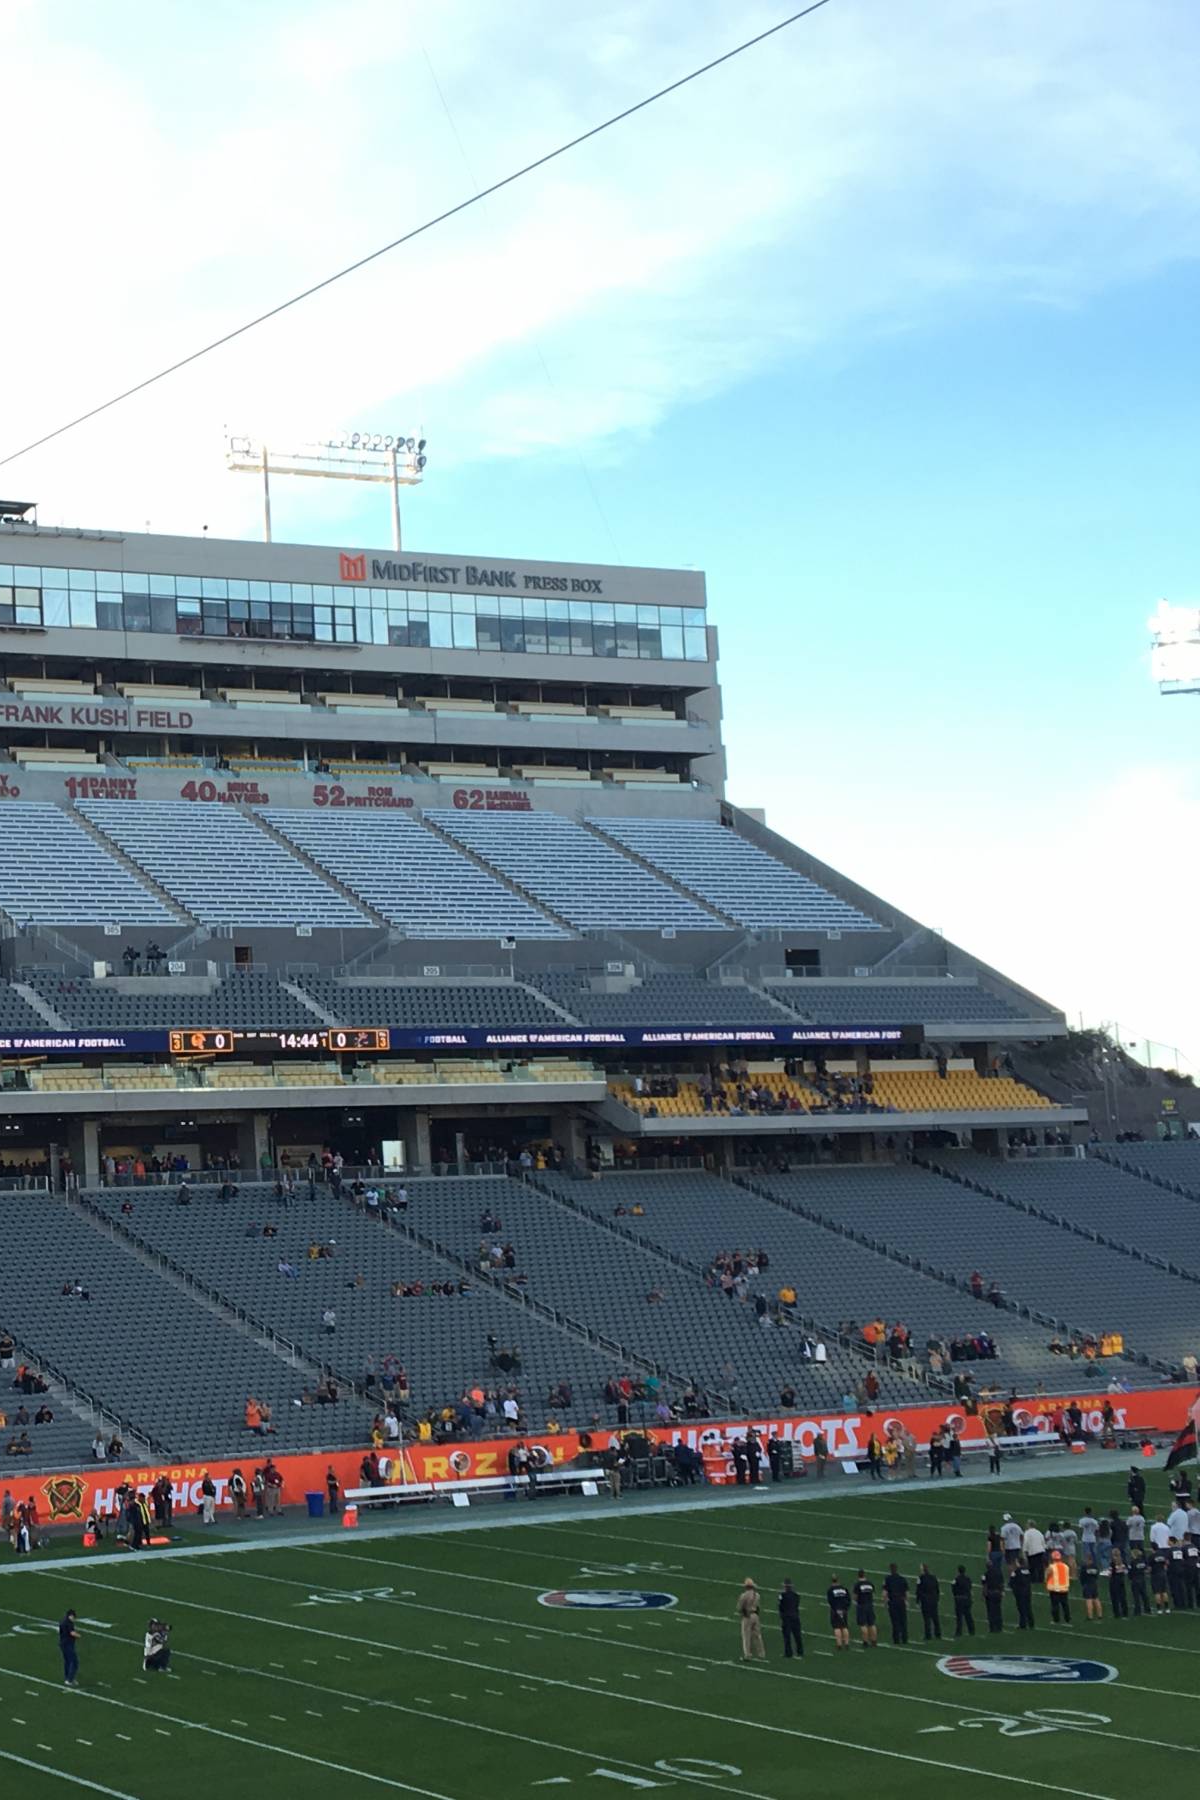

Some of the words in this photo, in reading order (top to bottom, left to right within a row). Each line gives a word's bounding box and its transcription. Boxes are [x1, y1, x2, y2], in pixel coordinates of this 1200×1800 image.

[523, 575, 568, 591] PRESS
[571, 578, 603, 594] BOX
[71, 706, 127, 726] KUSH
[137, 710, 193, 729] FIELD
[65, 776, 90, 799] 11
[89, 777, 137, 789] DANNY
[227, 781, 259, 793] MIKE
[180, 780, 217, 804] 40
[313, 784, 346, 808] 52
[368, 786, 393, 797] RON
[346, 796, 414, 809] PRITCHARD
[453, 788, 486, 811] 62
[169, 962, 185, 972] 204
[24, 1038, 76, 1048] AMERICAN
[78, 1038, 126, 1047] FOOTBALL
[215, 1034, 225, 1049] 0
[279, 1034, 319, 1048] 14:44
[321, 1037, 328, 1047] 1
[337, 1033, 346, 1047] 0
[379, 1037, 387, 1047] 3
[424, 1035, 467, 1044] FOOTBALL
[486, 1034, 528, 1043] ALLIANCE
[538, 1034, 582, 1043] AMERICAN
[584, 1033, 625, 1042] FOOTBALL
[642, 1033, 681, 1042] ALLIANCE
[691, 1032, 734, 1041] AMERICAN
[736, 1032, 775, 1040] FOOTBALL
[173, 1039, 181, 1050] 3
[958, 1709, 1112, 1738] 20
[588, 1757, 743, 1790] 10
